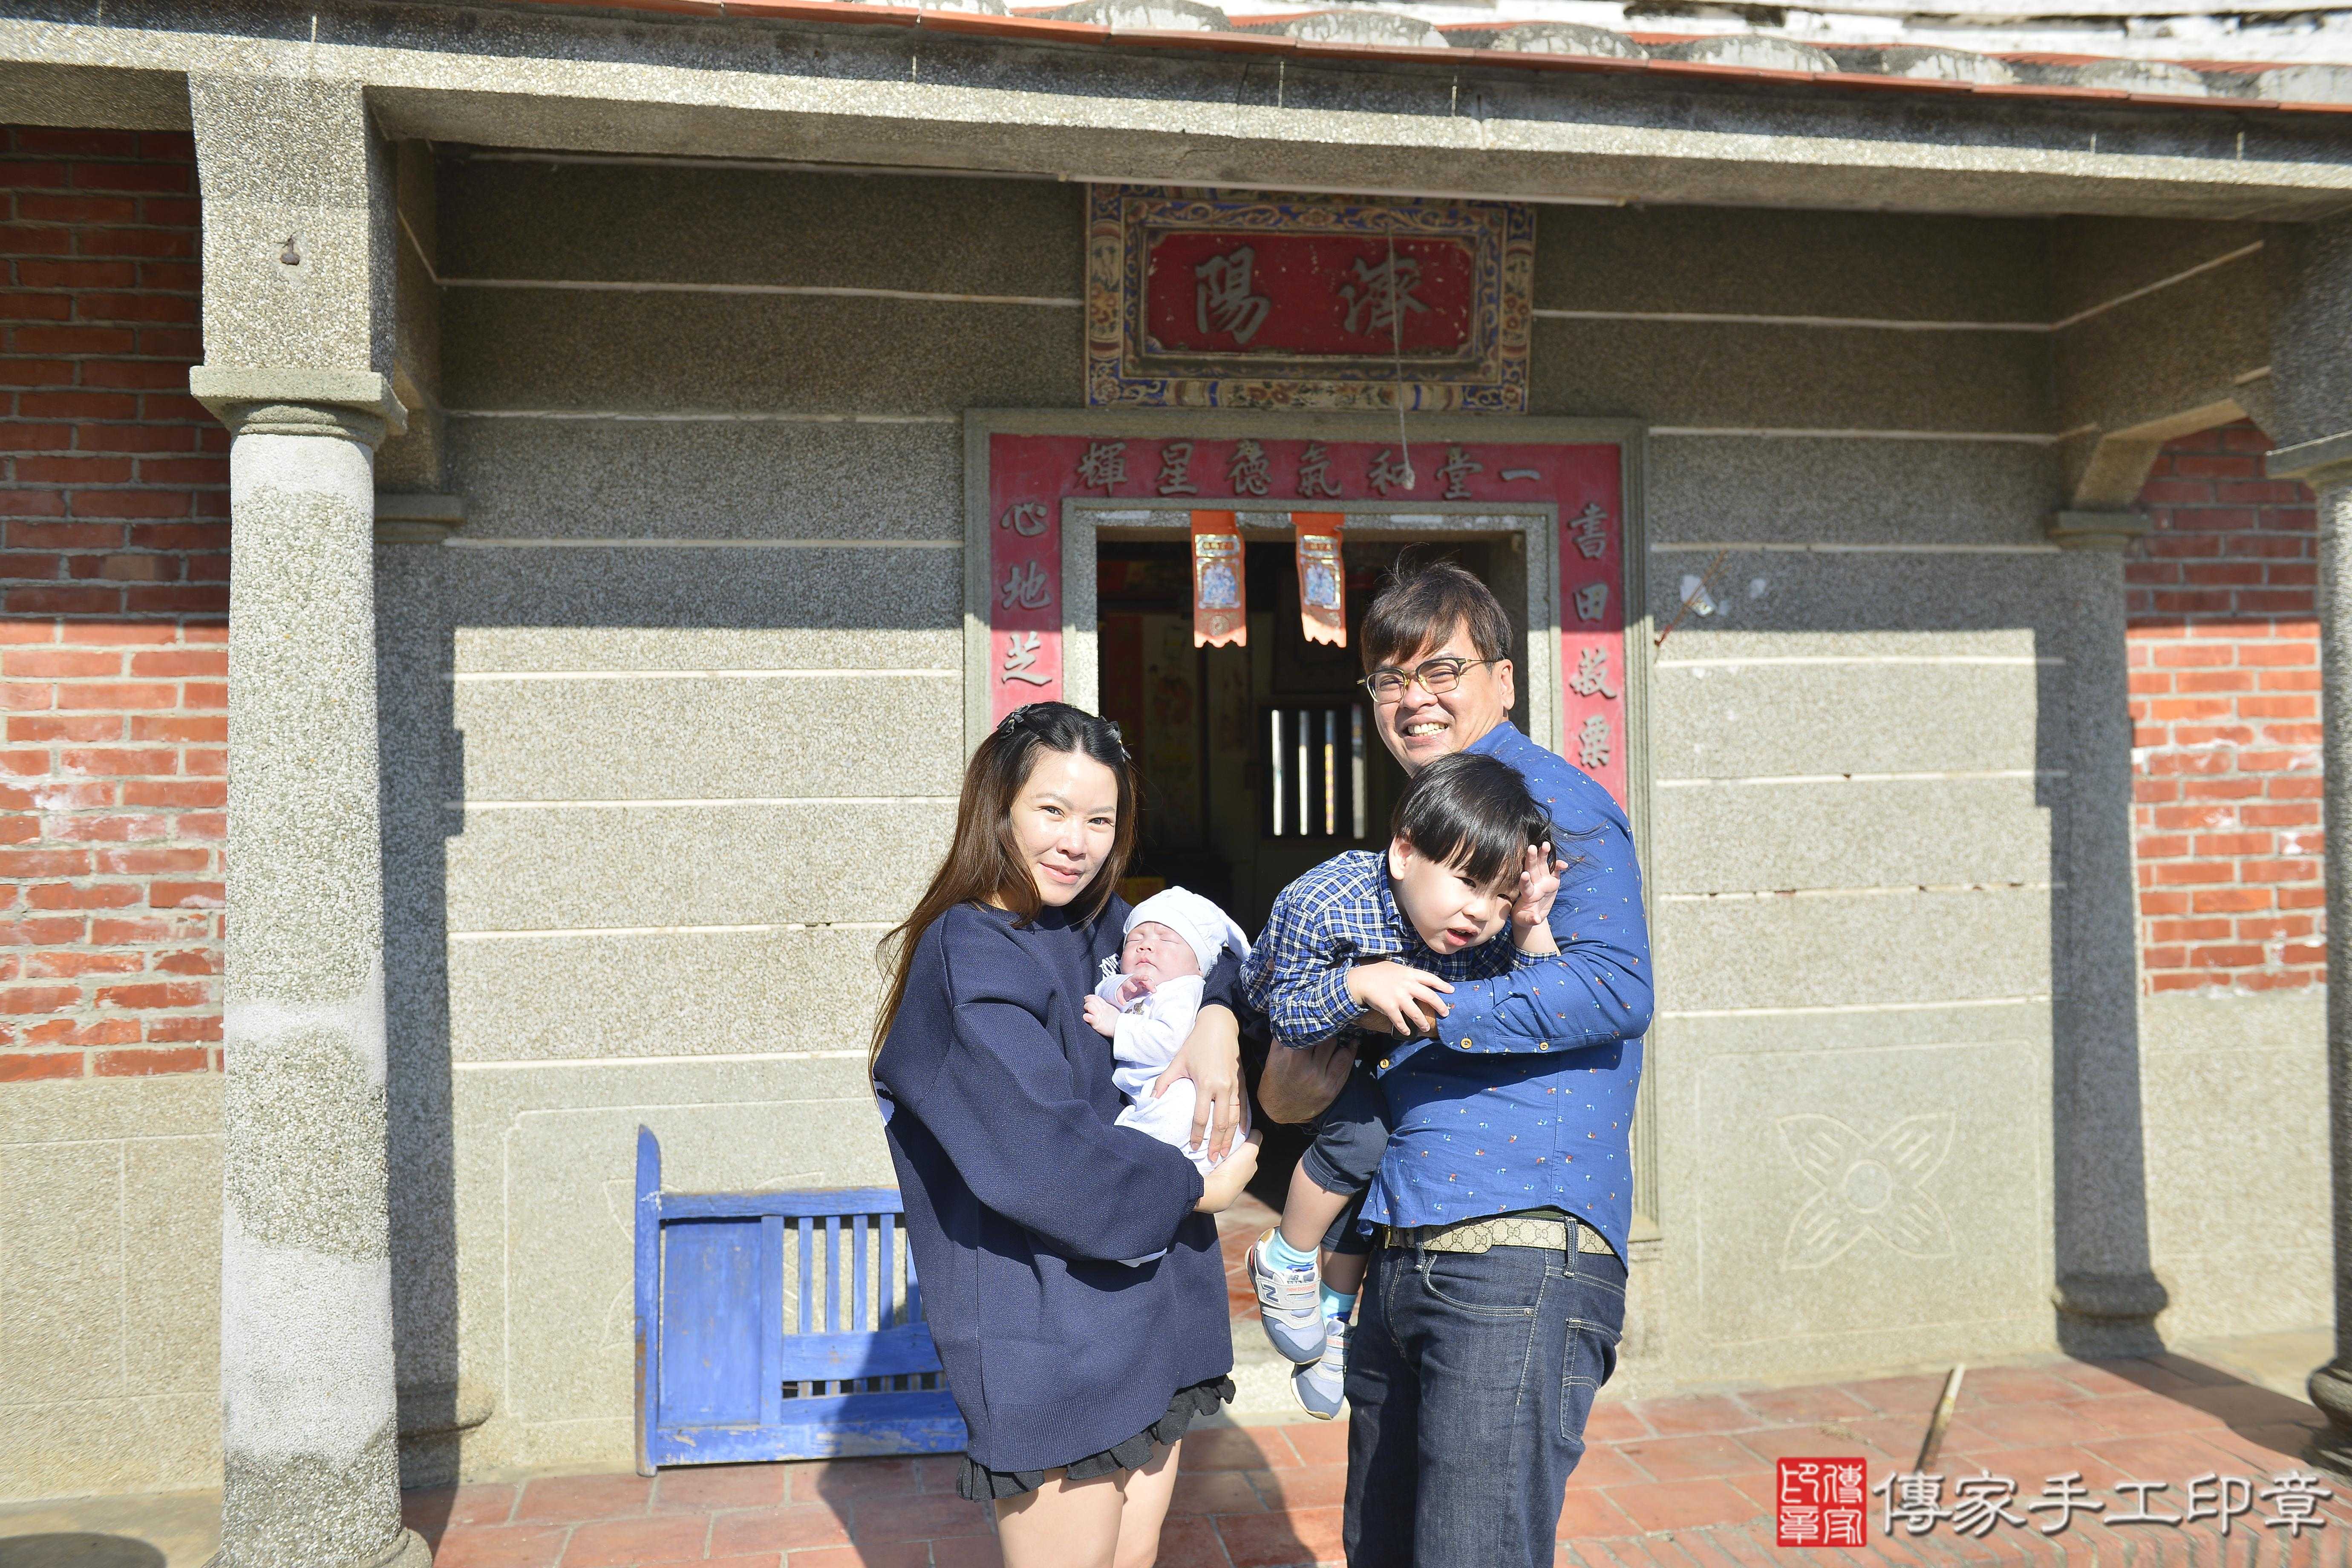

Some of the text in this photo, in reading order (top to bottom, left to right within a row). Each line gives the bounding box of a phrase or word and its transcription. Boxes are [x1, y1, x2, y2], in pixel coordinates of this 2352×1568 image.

[1195, 245, 1430, 343] 濟陽
[1000, 502, 1053, 687] 心地芝
